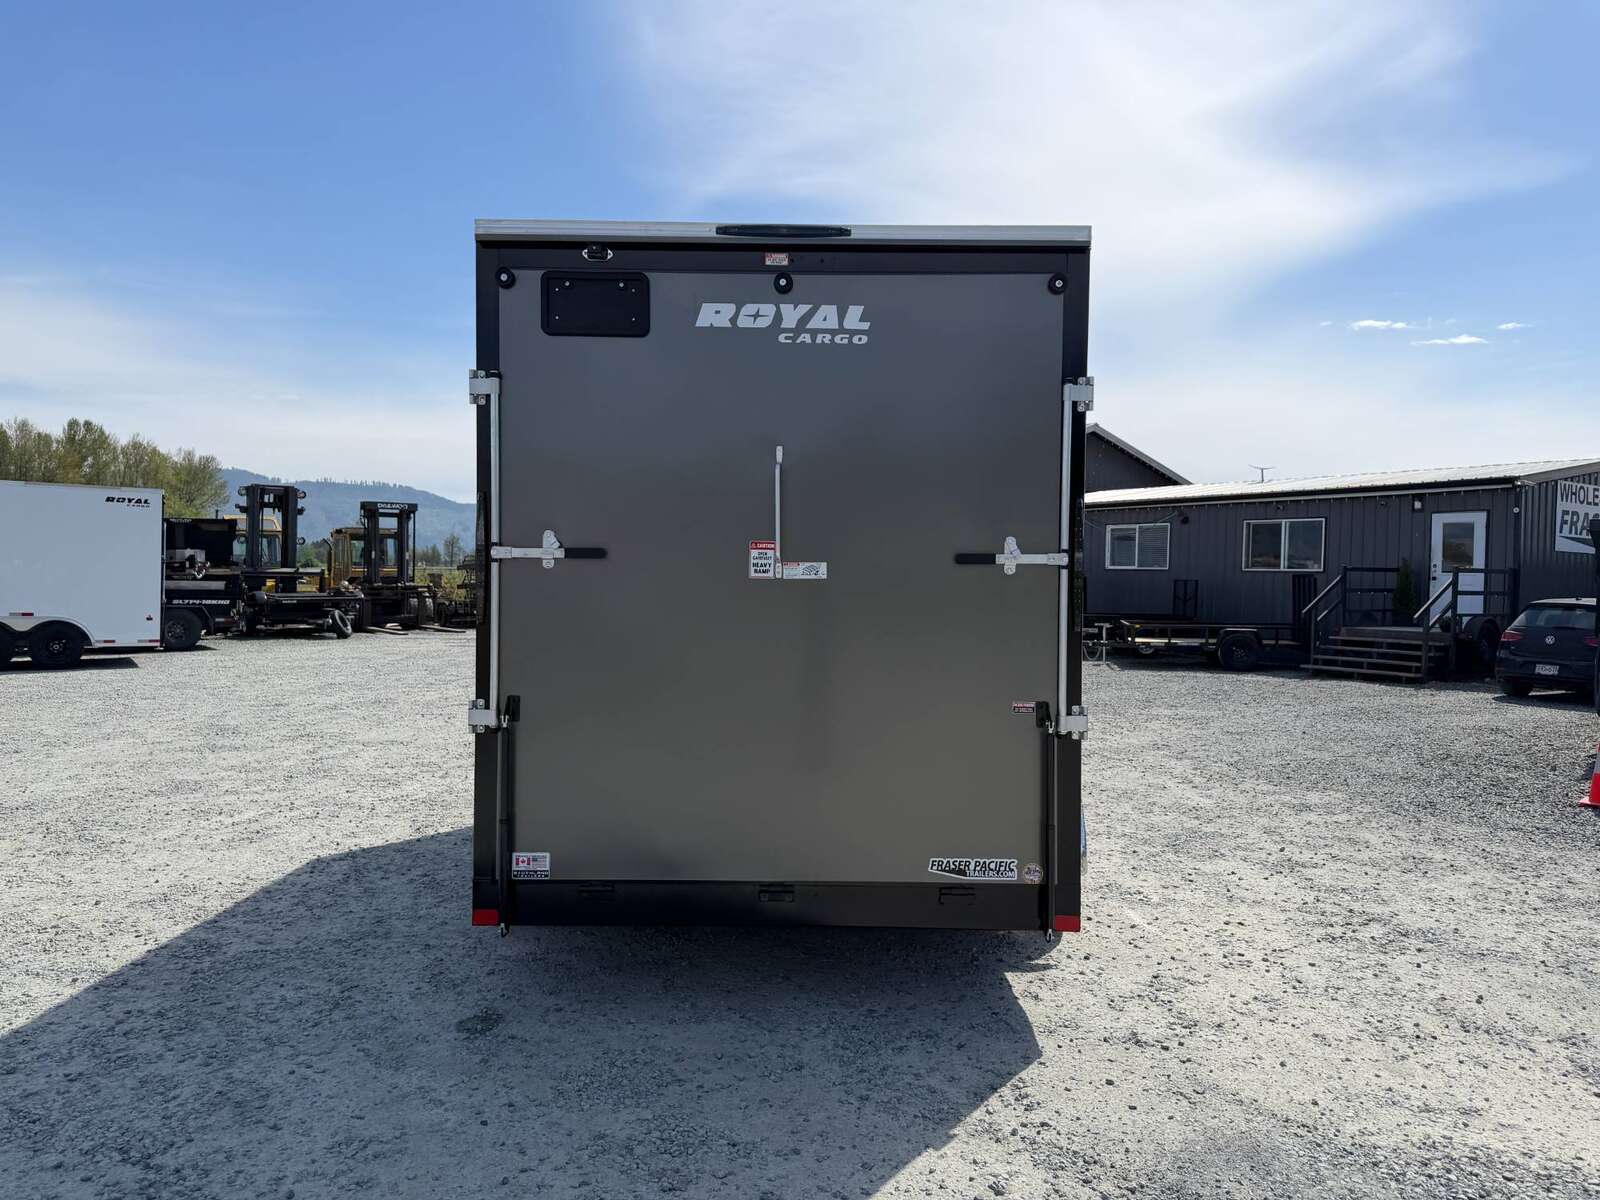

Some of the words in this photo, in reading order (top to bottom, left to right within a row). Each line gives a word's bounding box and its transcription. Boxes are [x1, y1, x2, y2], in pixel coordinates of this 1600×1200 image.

[695, 302, 871, 330] ROYAL
[777, 332, 869, 345] CARGO
[105, 496, 151, 505] ROYAL
[1559, 482, 1600, 507] WHOLE
[929, 859, 972, 871] FRASER
[973, 859, 1017, 872] PACIFIC
[965, 870, 1016, 878] TRAILERS.COM
